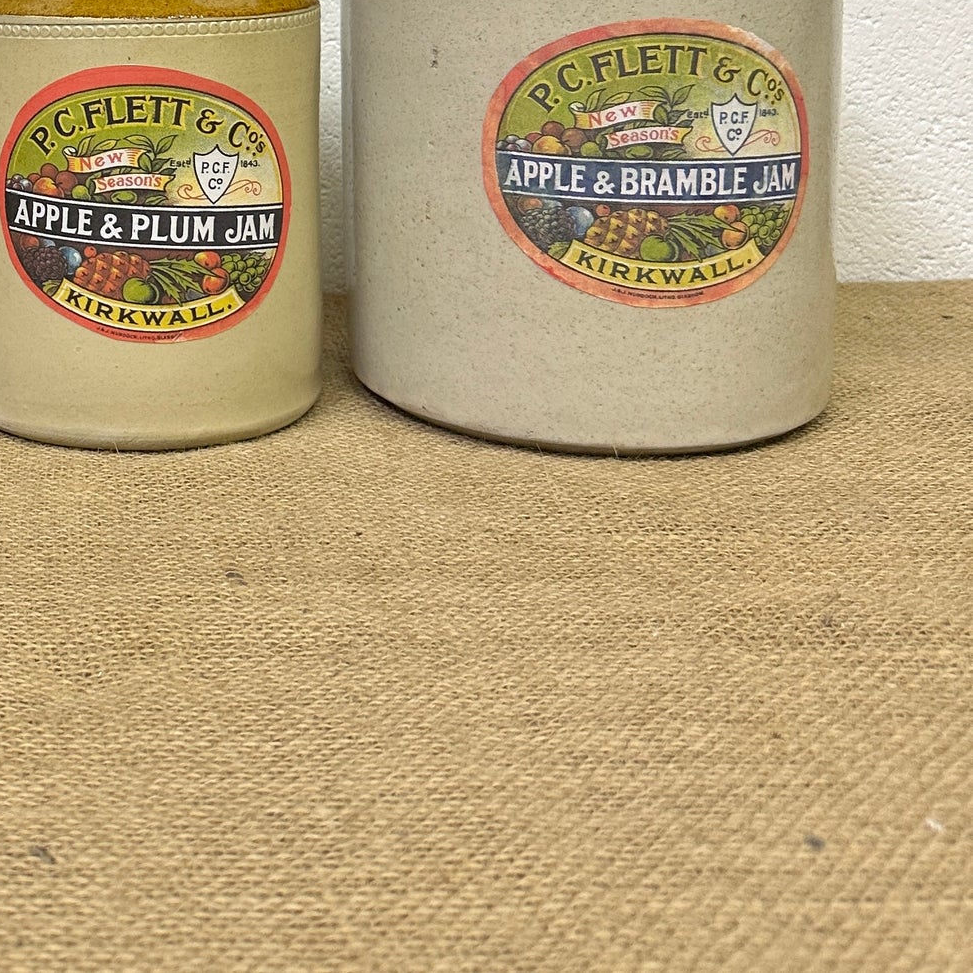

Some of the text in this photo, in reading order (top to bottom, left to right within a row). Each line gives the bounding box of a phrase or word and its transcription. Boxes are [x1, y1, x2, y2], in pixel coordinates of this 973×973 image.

[714, 56, 741, 83] &
[196, 109, 224, 134] &
[588, 103, 637, 128] New
[609, 126, 680, 146] Season's
[79, 151, 123, 171] New
[97, 174, 162, 190] Season's
[504, 159, 796, 197] APPLE & BRAMBLE JAM
[14, 199, 275, 244] APPLE & PLUM JAM
